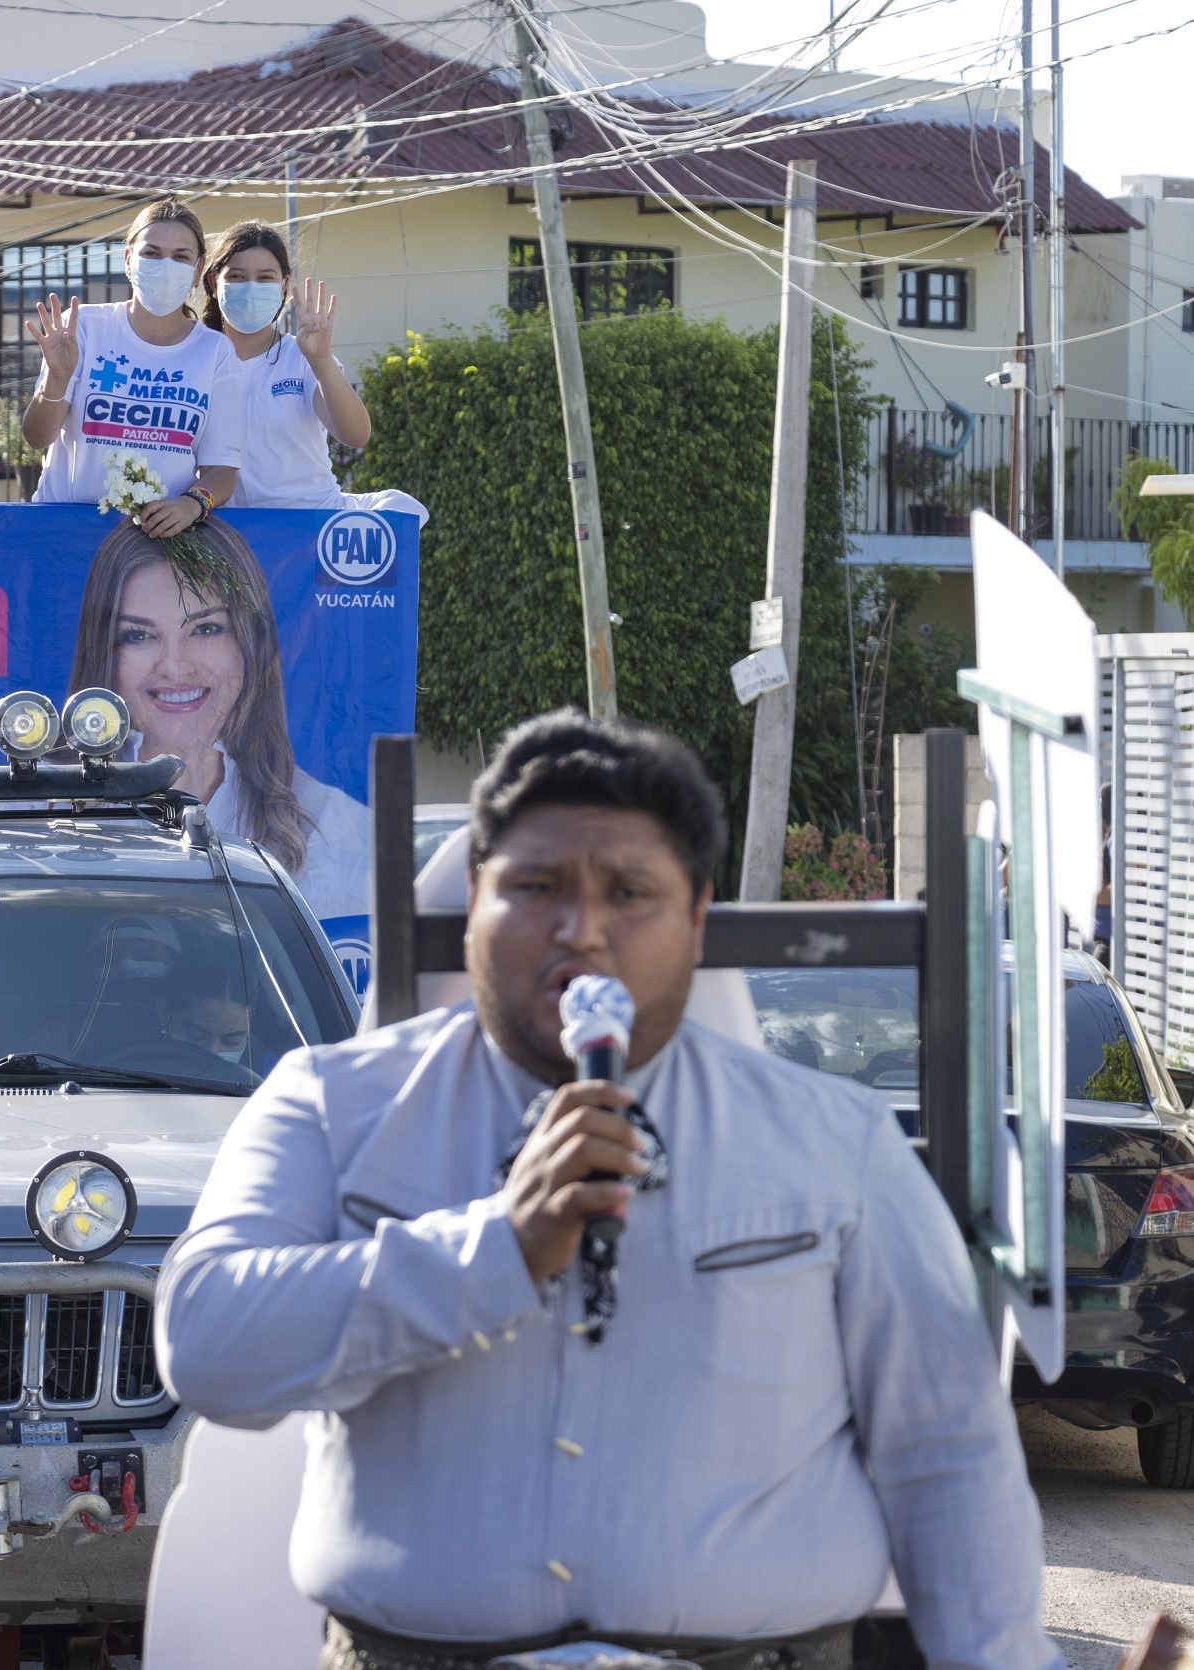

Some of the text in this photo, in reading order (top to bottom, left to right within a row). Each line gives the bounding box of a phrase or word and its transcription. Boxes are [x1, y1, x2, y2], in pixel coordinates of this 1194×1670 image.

[131, 367, 184, 383] MÁS
[128, 383, 209, 411] MÉRIDA
[87, 399, 200, 436] CECILIA
[86, 437, 191, 455] DIPUTADA FEDERAL DISTRITO
[122, 429, 169, 442] PATRÓN
[332, 527, 382, 565] PAN
[315, 591, 395, 608] YUCATÁN
[342, 958, 372, 995] AN
